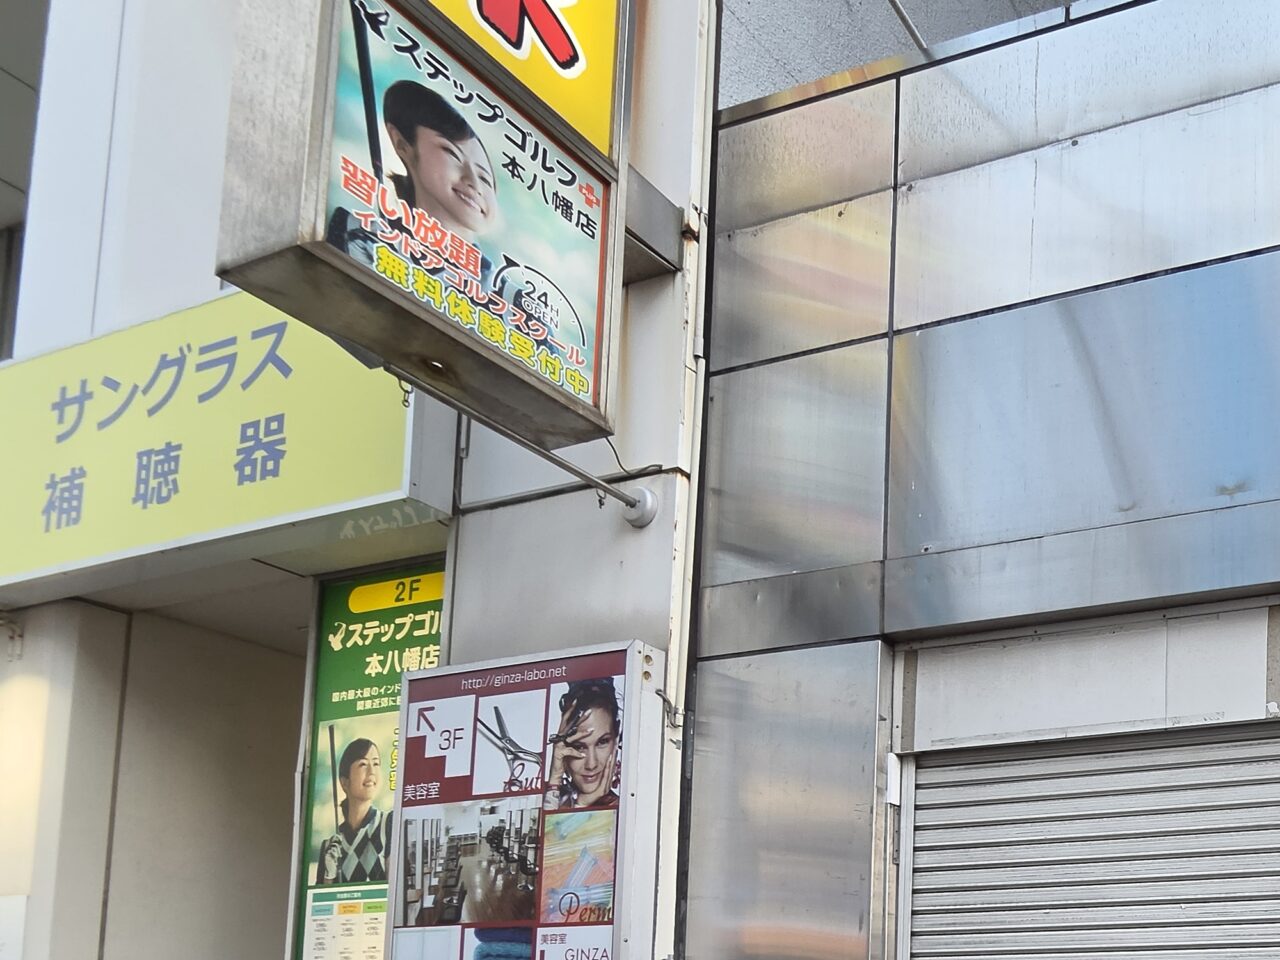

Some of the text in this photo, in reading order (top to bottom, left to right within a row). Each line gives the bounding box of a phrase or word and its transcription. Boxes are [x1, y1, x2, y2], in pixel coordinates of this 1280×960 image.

[395, 27, 578, 188] ステップゴルフ
[500, 151, 597, 240] 本八幡店
[340, 156, 481, 276] 習い放題
[356, 212, 585, 366] インドアゴルフスクール
[523, 280, 559, 317] 24H
[374, 246, 590, 396] 無料体験受付中
[522, 300, 559, 329] OPEN
[50, 321, 293, 443] サングラス
[41, 412, 287, 534] 補聴器
[394, 579, 421, 602] 2F
[365, 644, 441, 677] 本八幡店
[461, 665, 567, 691] http://ginza-labo.net
[439, 727, 464, 751] 3F
[403, 782, 441, 801] 美容室
[558, 892, 613, 922] Perm
[540, 933, 567, 945] 美容室
